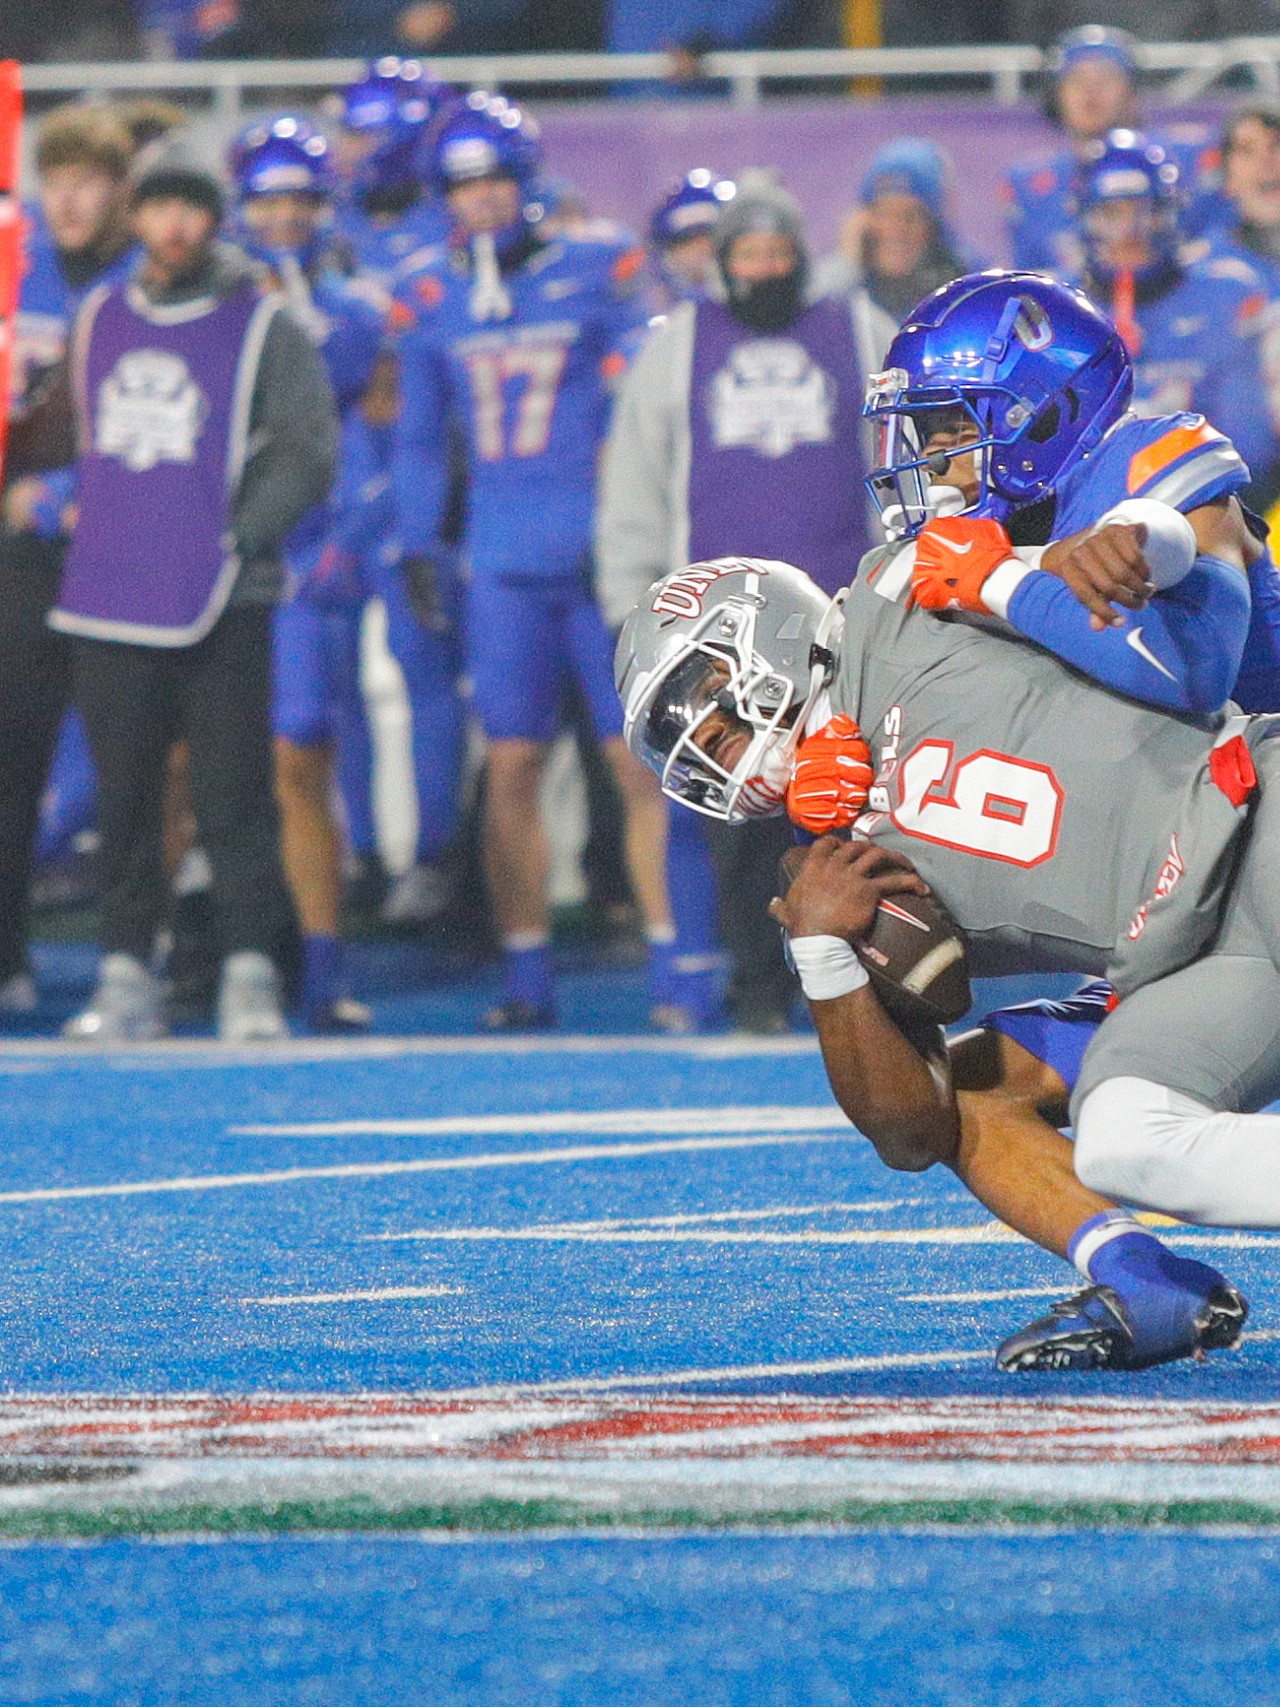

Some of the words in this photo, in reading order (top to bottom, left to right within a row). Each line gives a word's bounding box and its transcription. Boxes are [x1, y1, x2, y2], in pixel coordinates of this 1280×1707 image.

[464, 347, 570, 462] 17
[651, 557, 769, 619] UNLV
[890, 738, 1065, 870] 6
